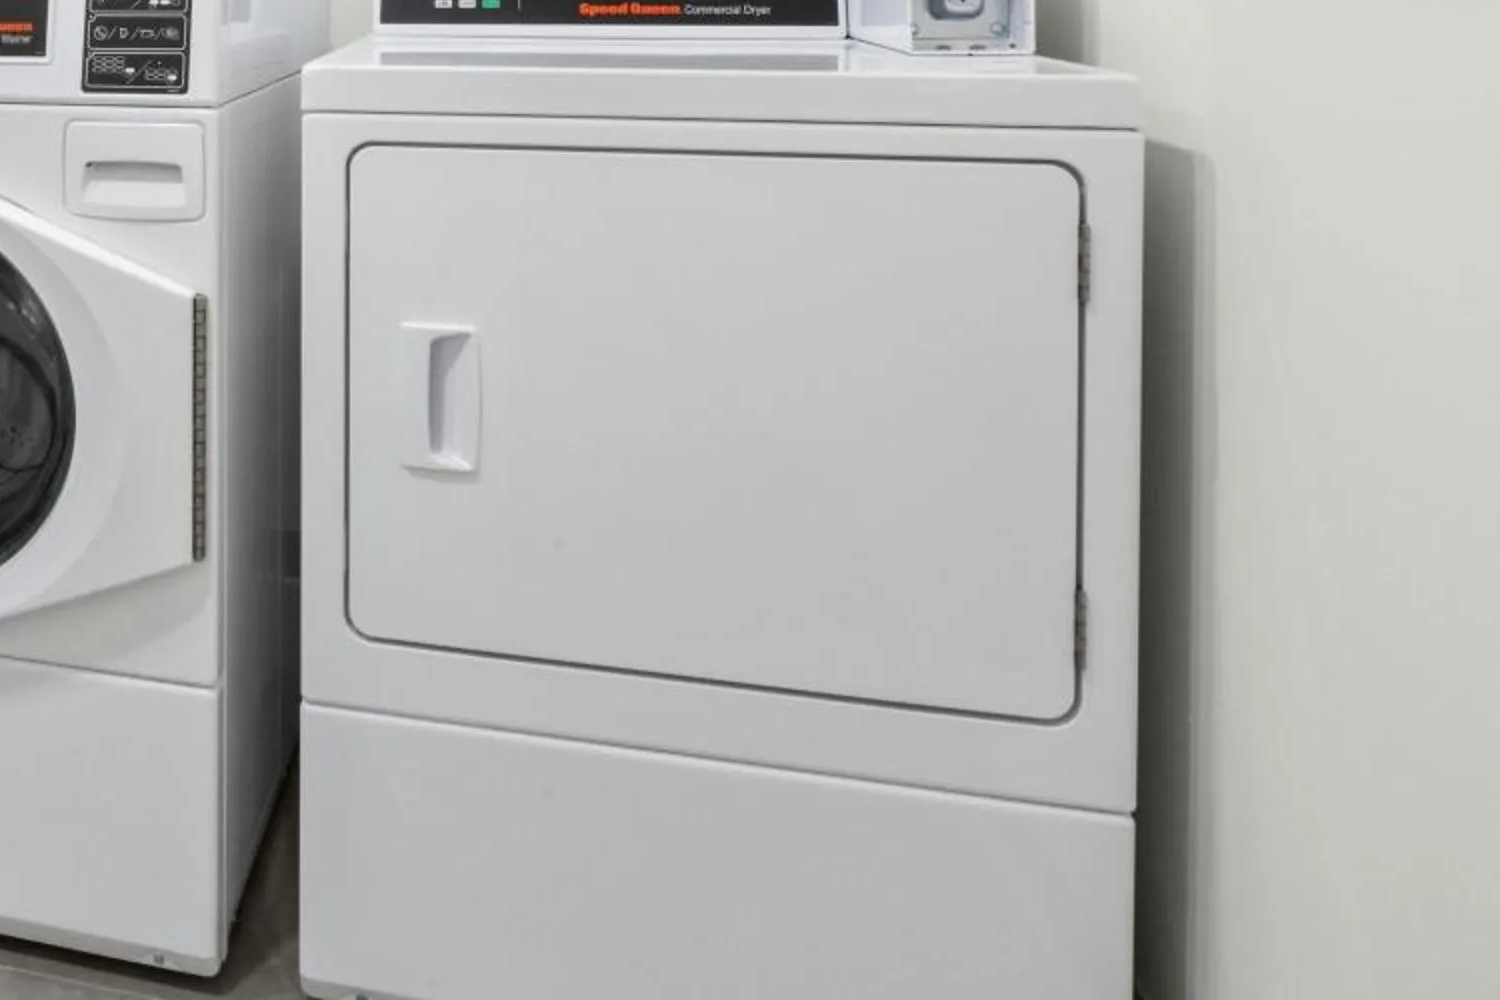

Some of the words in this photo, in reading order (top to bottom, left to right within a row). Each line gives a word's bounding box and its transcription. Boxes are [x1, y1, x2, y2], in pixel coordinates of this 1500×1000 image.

[579, 3, 628, 16] Speed
[630, 3, 681, 15] Queen
[684, 4, 741, 15] Commercial
[743, 4, 771, 16] Dryer
